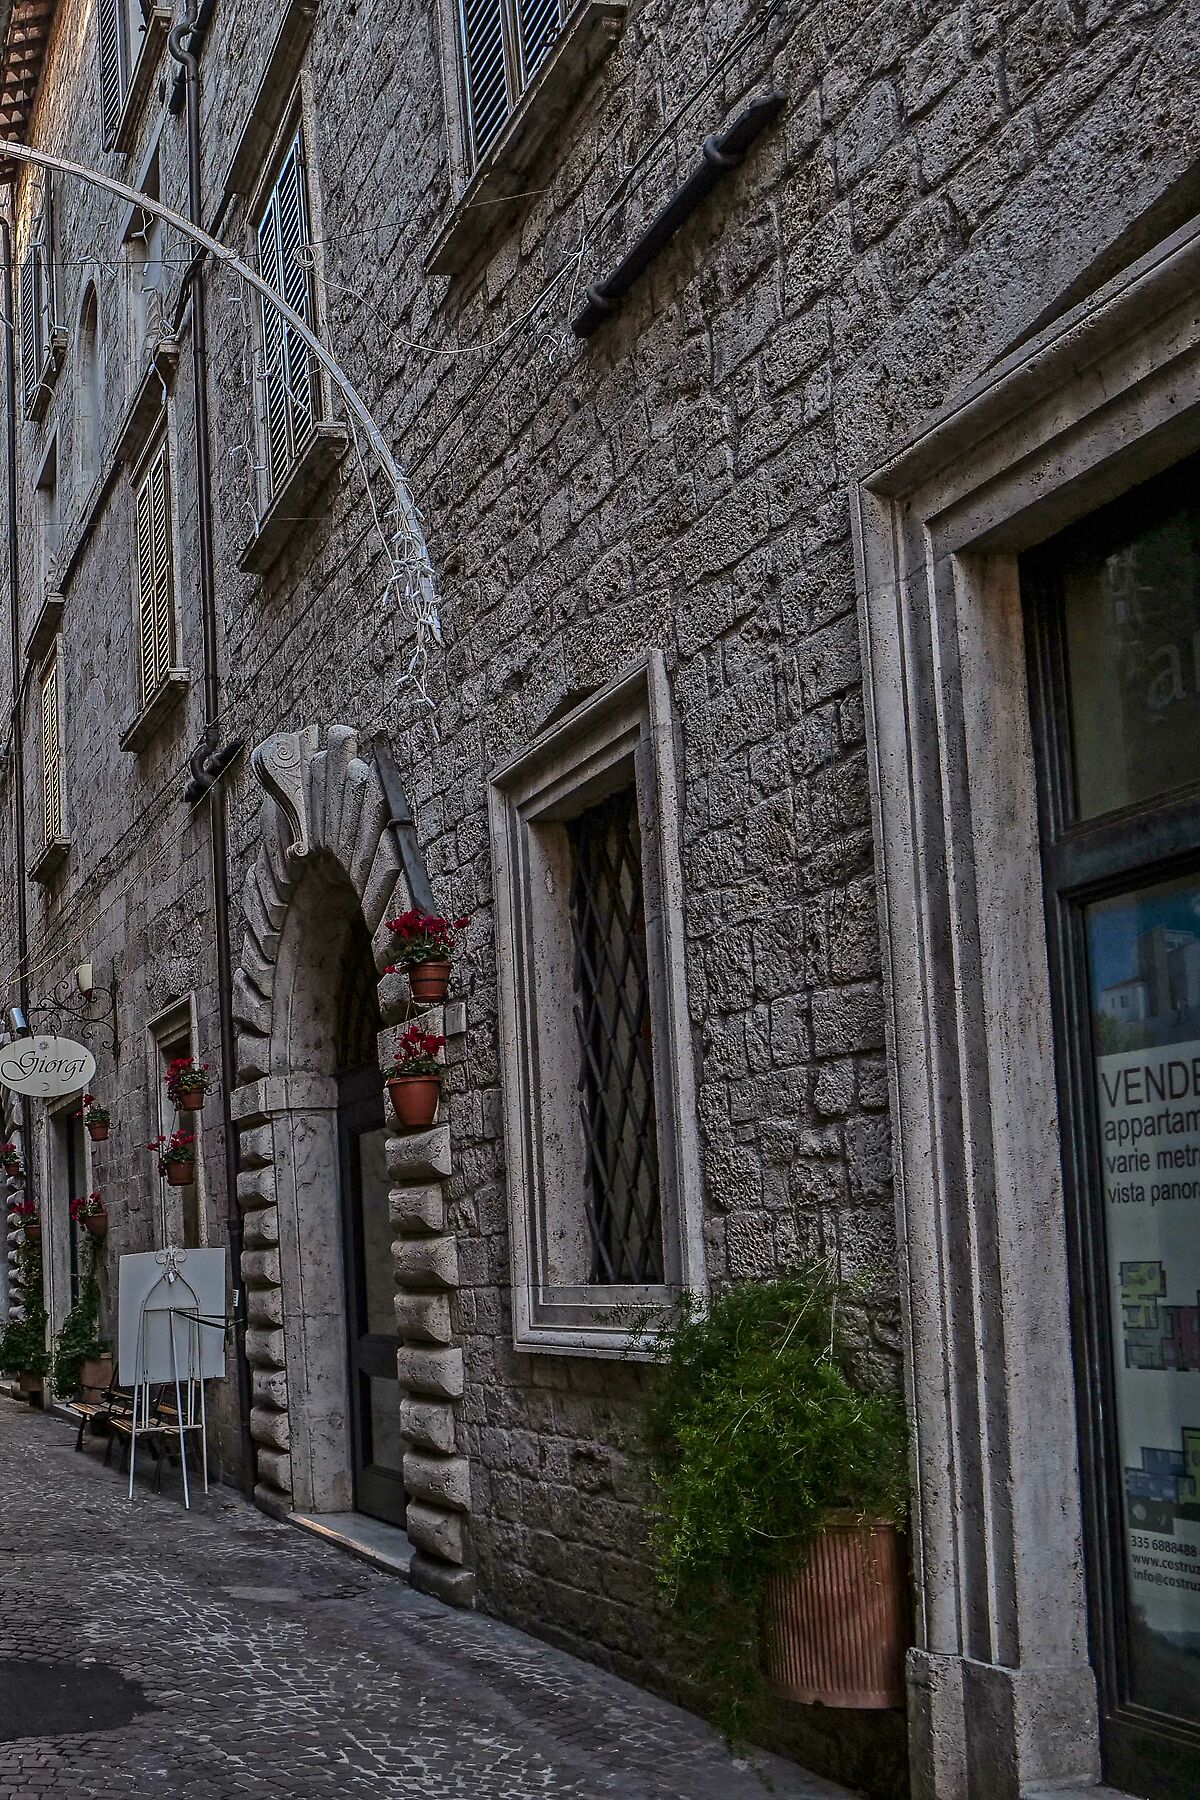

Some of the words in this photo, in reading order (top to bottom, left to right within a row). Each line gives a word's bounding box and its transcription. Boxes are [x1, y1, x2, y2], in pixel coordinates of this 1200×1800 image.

[1, 1051, 87, 1081] Giorgi
[1106, 1147, 1150, 1174] varie
[1156, 1144, 1200, 1169] metr
[1108, 1182, 1145, 1204] vista
[1151, 1181, 1200, 1206] panor
[1131, 1535, 1149, 1549] 335
